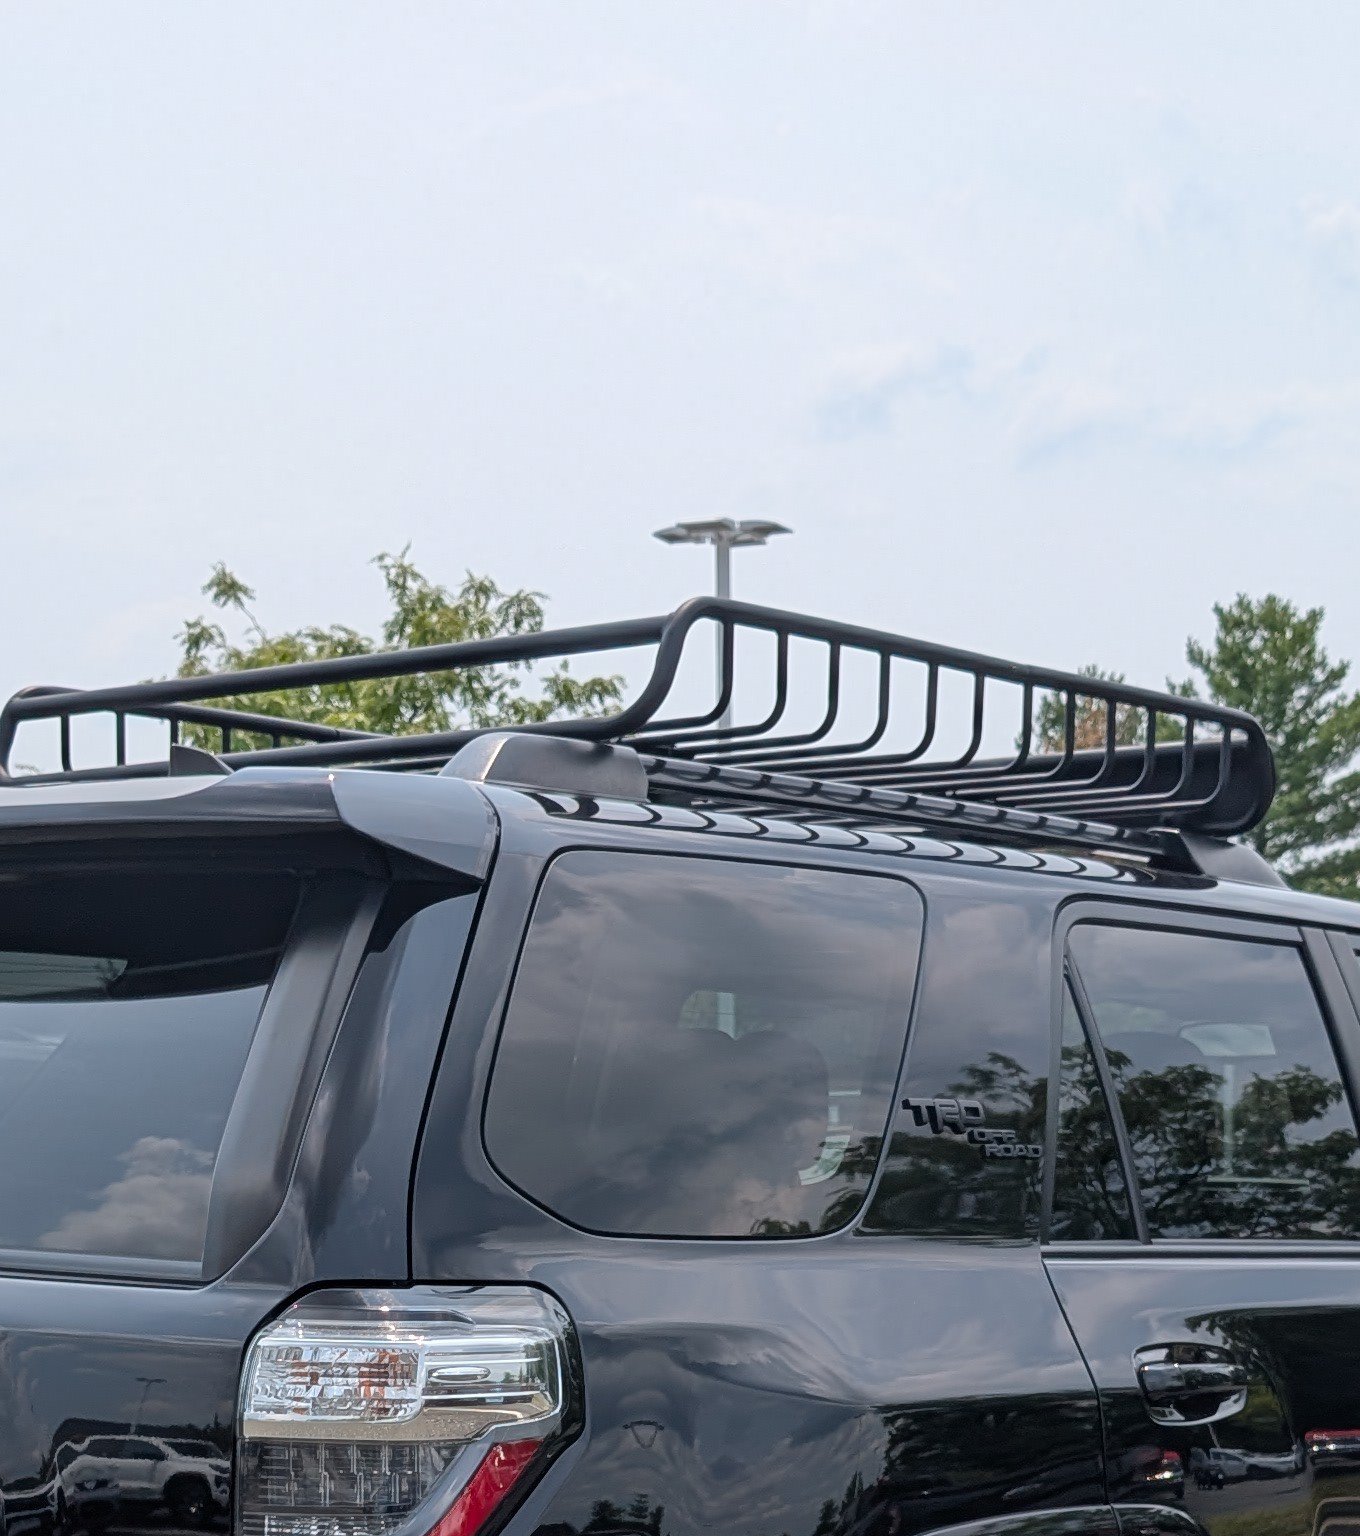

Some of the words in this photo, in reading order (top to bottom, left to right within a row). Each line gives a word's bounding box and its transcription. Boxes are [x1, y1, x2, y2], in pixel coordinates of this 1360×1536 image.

[902, 1098, 986, 1134] TRD
[967, 1129, 1016, 1144] OFF
[981, 1144, 1043, 1159] ROAD
